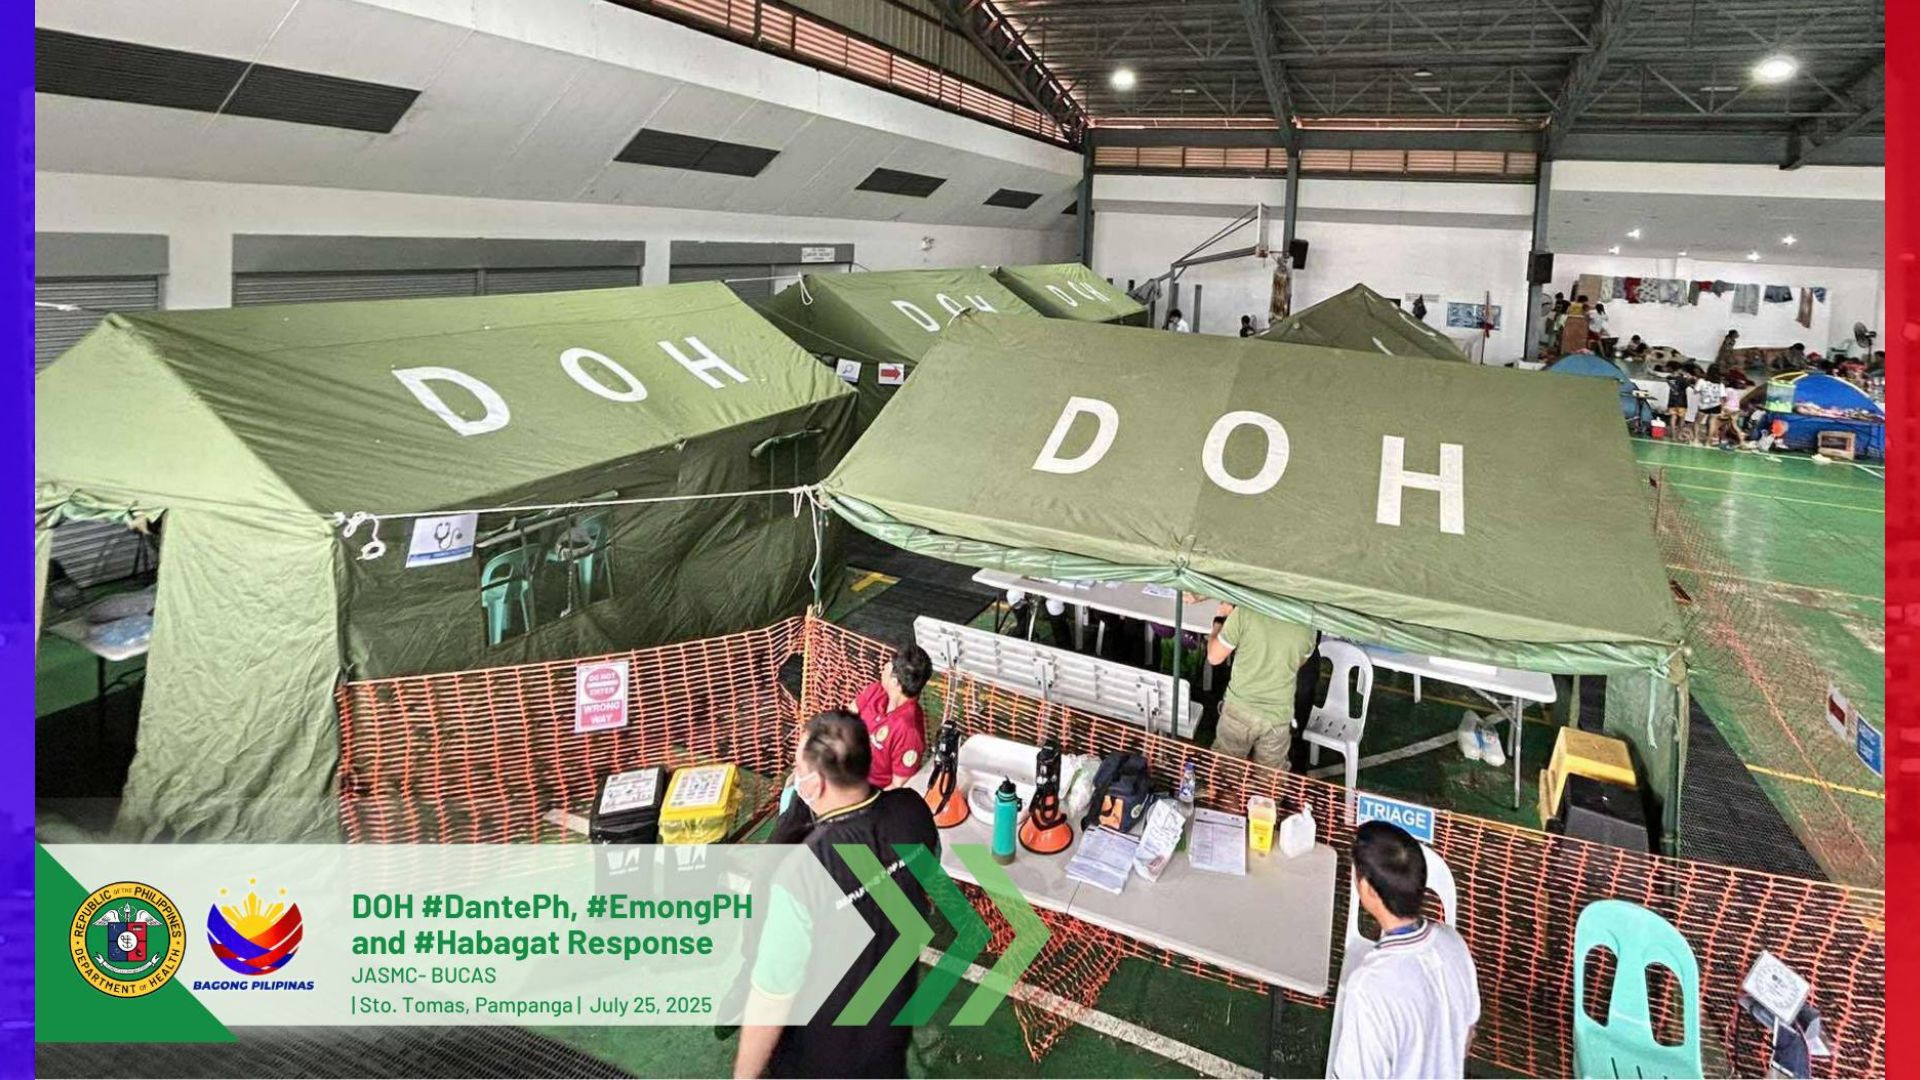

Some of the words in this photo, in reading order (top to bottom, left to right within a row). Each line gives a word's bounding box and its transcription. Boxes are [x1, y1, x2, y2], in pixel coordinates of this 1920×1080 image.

[1032, 396, 1465, 535] DOH
[583, 700, 621, 713] WRONG
[591, 713, 613, 724] WAY
[1363, 799, 1428, 830] TRIAGE
